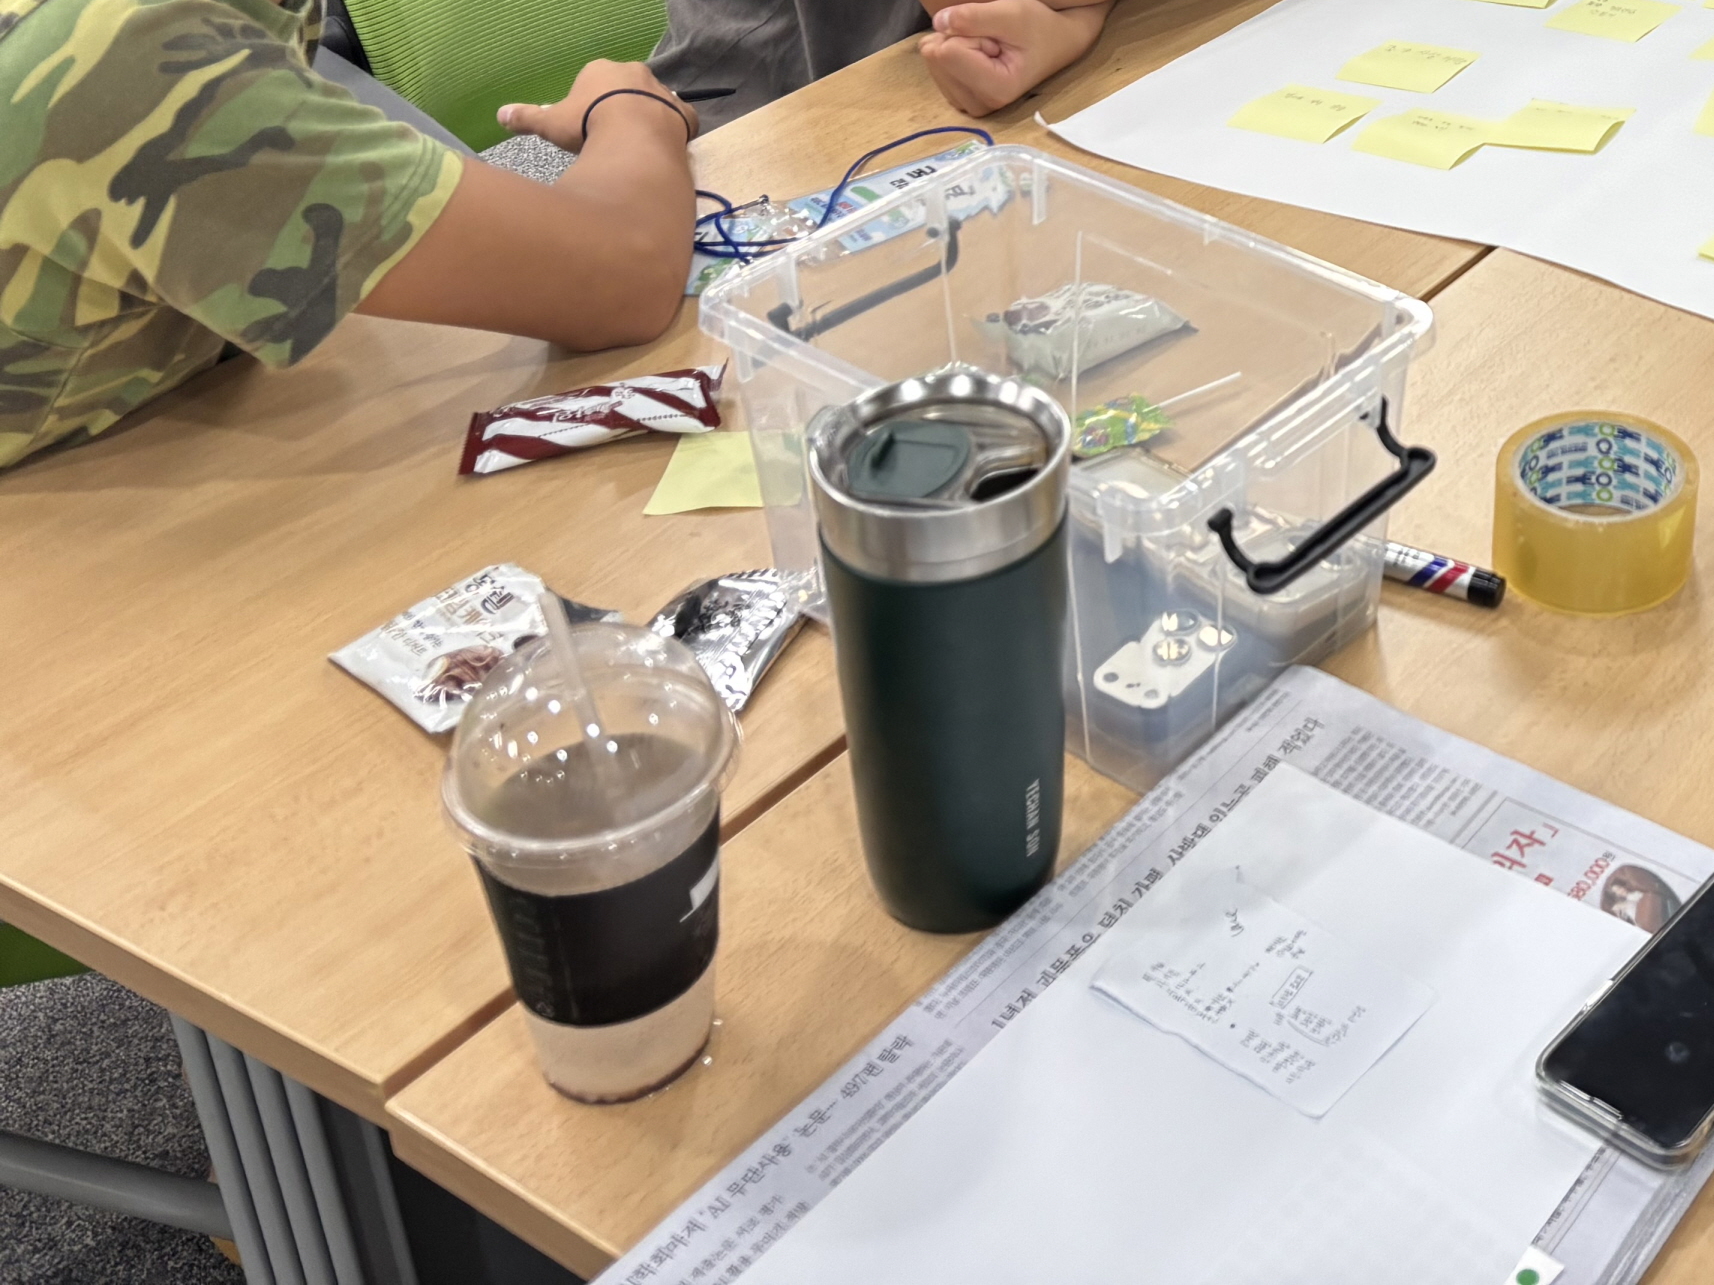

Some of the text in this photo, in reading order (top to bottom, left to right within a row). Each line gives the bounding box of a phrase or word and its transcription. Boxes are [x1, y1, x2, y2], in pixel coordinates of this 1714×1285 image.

[1278, 714, 1326, 760] 적었다
[1025, 778, 1040, 857] YECHAN SON
[878, 1032, 915, 1068] 탈락
